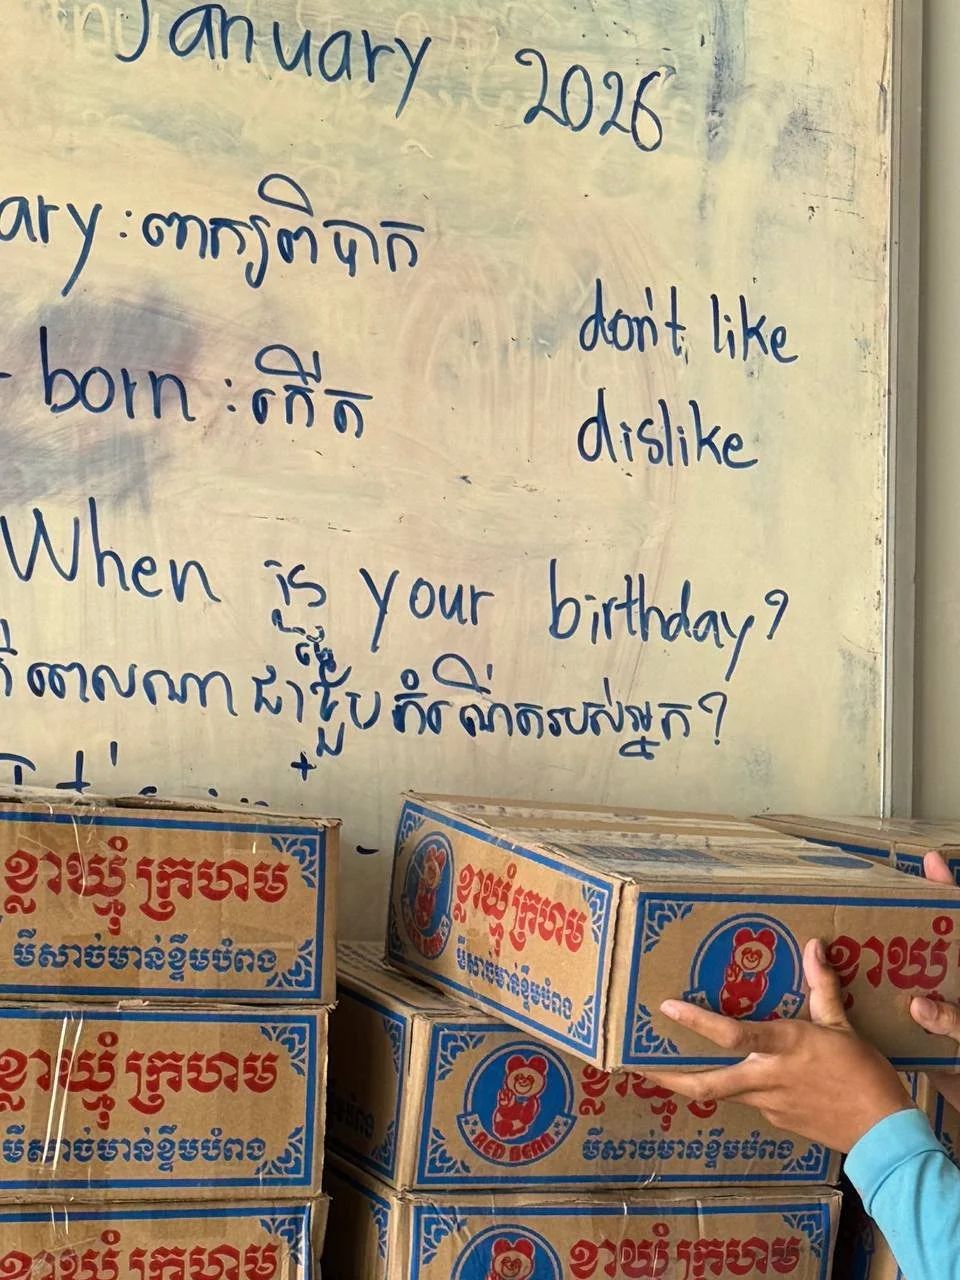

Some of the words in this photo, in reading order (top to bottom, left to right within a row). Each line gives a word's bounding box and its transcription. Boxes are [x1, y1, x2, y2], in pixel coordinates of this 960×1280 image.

[515, 48, 662, 152] 2026
[710, 292, 799, 364] like
[578, 387, 759, 471] dislike
[0, 496, 220, 604] When
[264, 560, 327, 608] is
[360, 565, 496, 653] your
